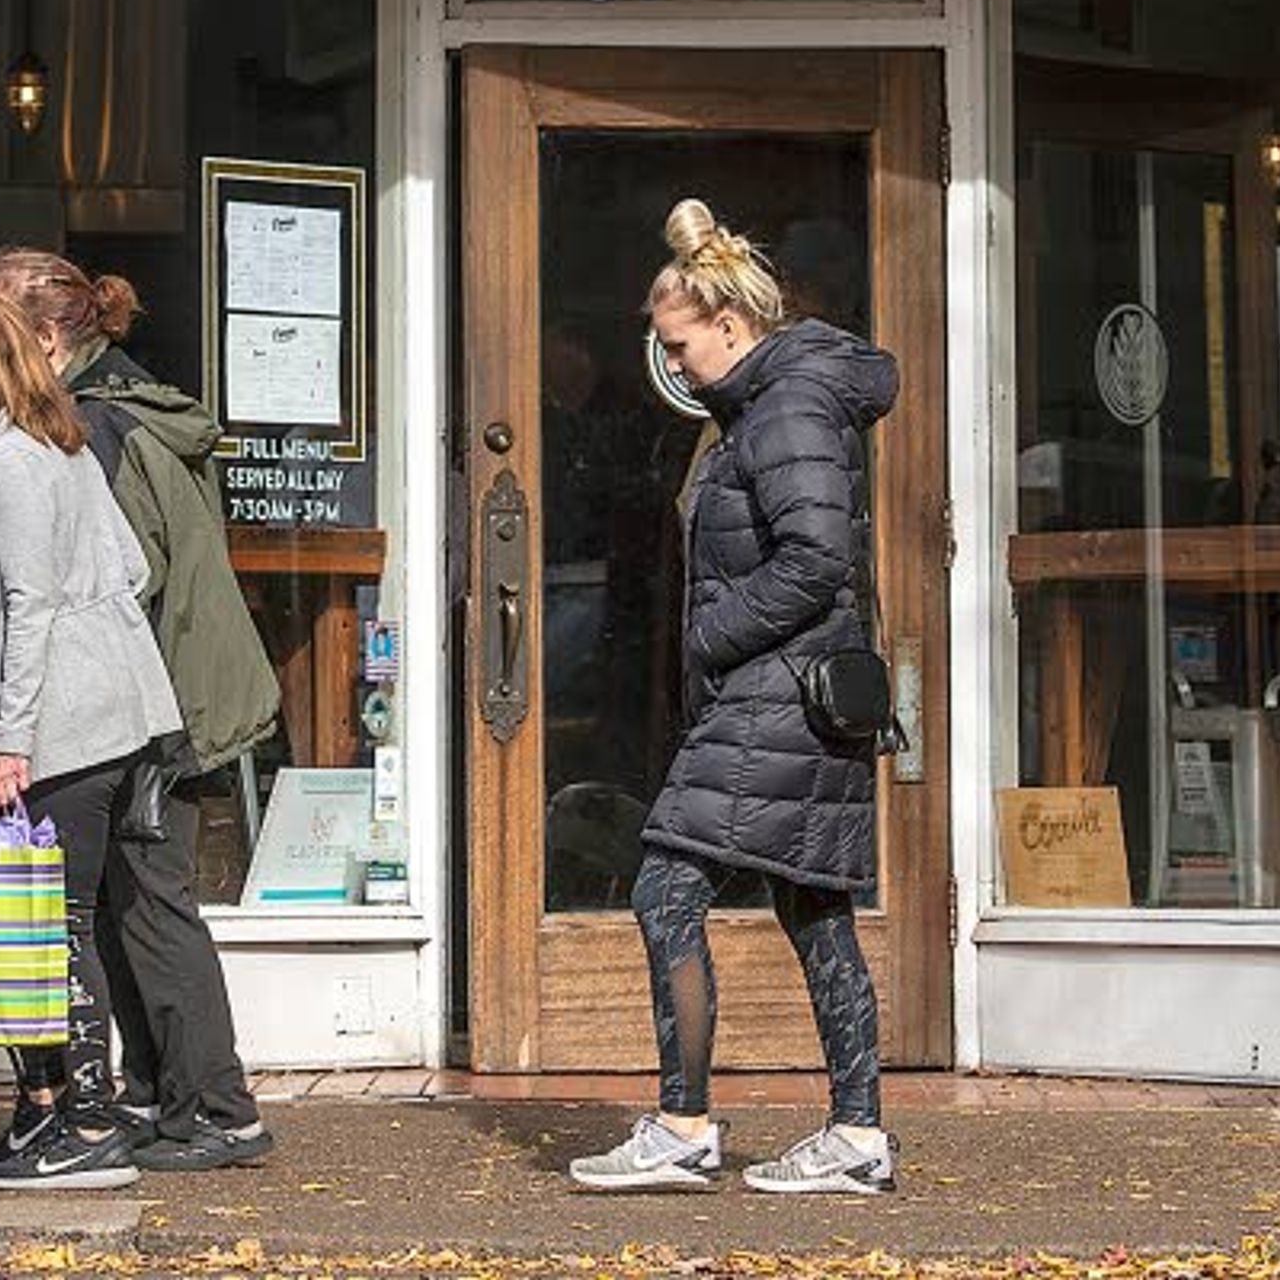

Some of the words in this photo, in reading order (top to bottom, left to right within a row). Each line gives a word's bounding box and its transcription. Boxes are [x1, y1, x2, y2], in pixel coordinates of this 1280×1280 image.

[243, 438, 281, 460] FULL
[282, 439, 330, 461] MENU
[227, 467, 286, 489] SERVED
[286, 470, 314, 490] ALL
[317, 471, 344, 490] DAY
